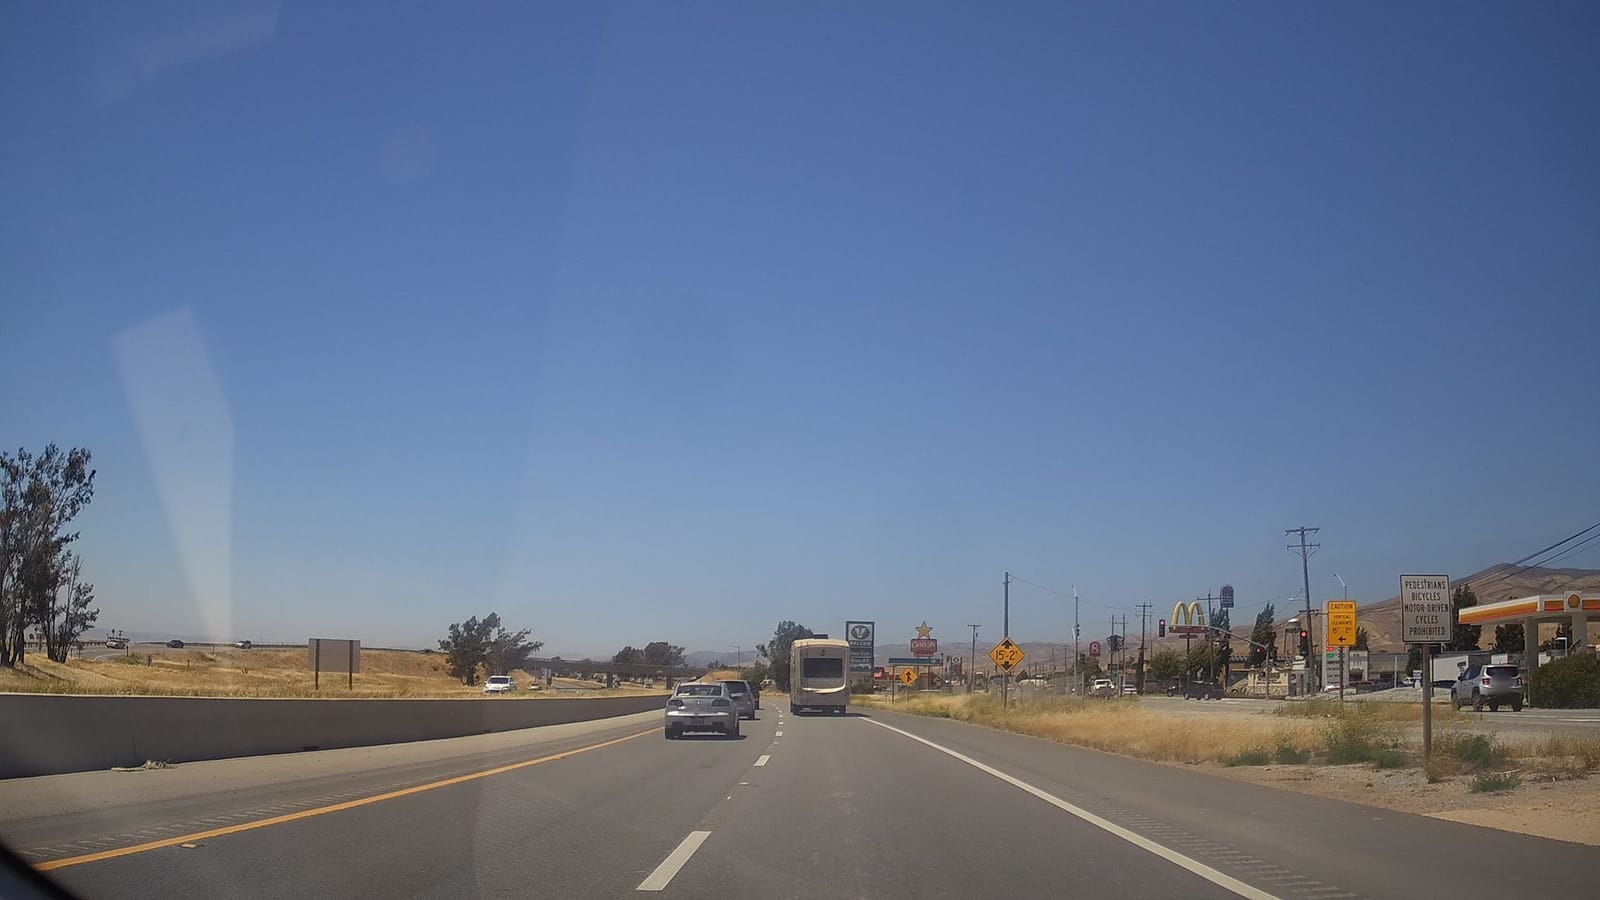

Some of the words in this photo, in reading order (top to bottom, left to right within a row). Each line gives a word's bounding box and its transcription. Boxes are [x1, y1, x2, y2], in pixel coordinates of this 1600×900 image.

[1405, 580, 1446, 590] PEDESTRIANS
[1411, 592, 1441, 601] BICYCLES
[1404, 603, 1449, 613] MOTOR-DRIVEN
[1415, 615, 1439, 624] CYCLES
[1409, 627, 1446, 636] PROHIBITED
